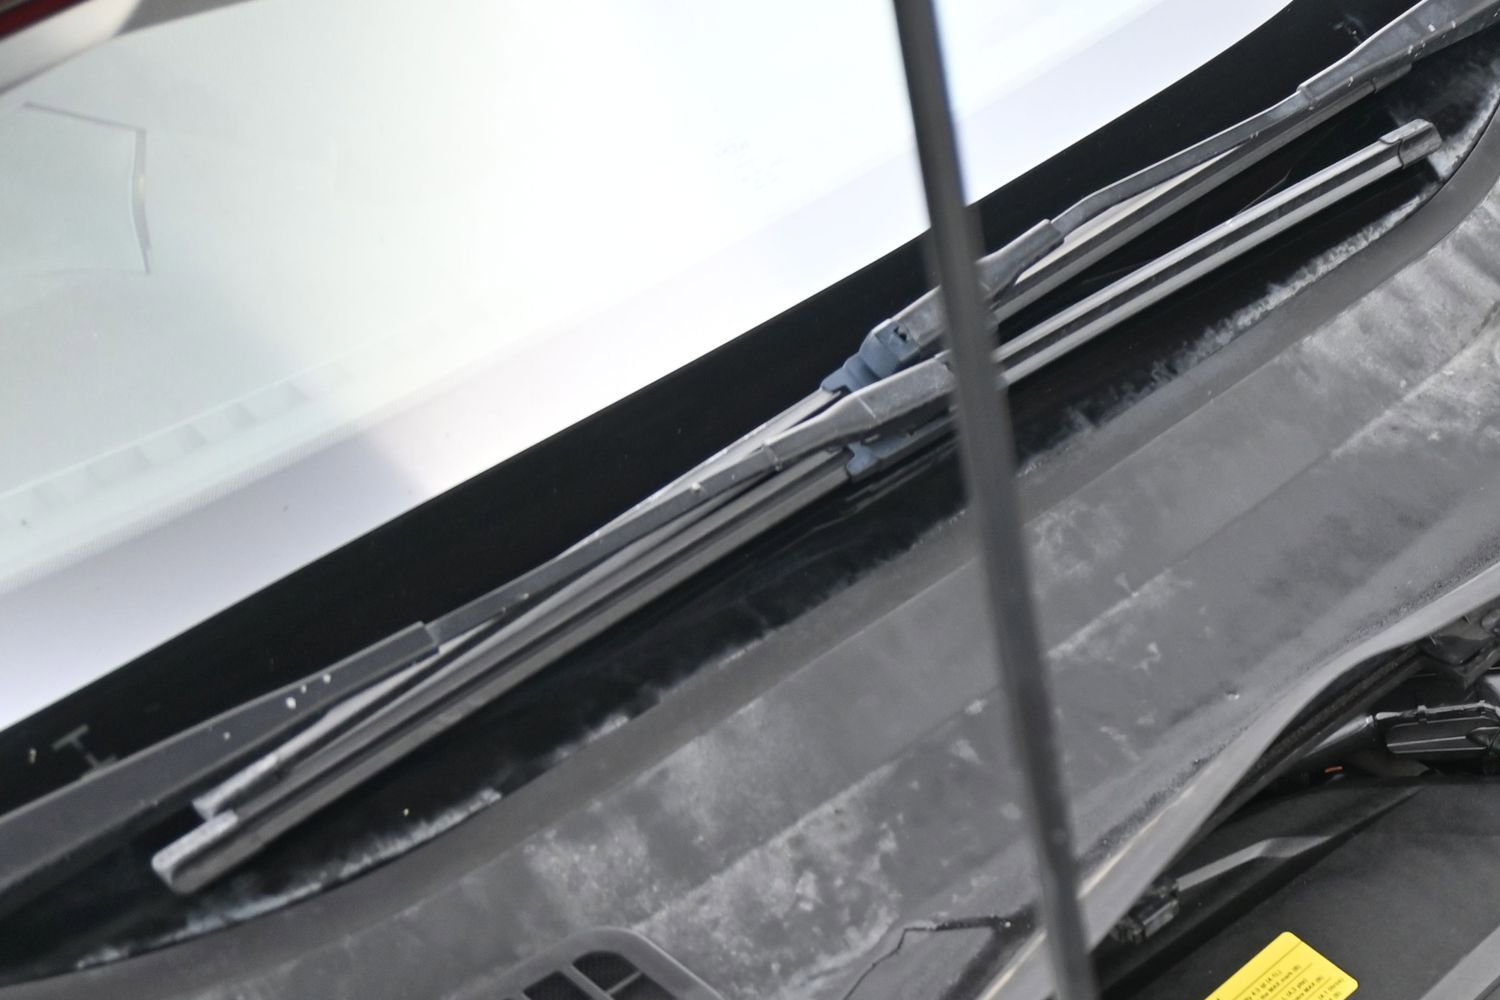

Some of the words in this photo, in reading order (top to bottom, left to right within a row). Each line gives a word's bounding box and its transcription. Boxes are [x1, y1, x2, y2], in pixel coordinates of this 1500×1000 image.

[1268, 982, 1279, 992] MAX
[1280, 971, 1292, 982] mark
[1303, 982, 1315, 992] MAX
